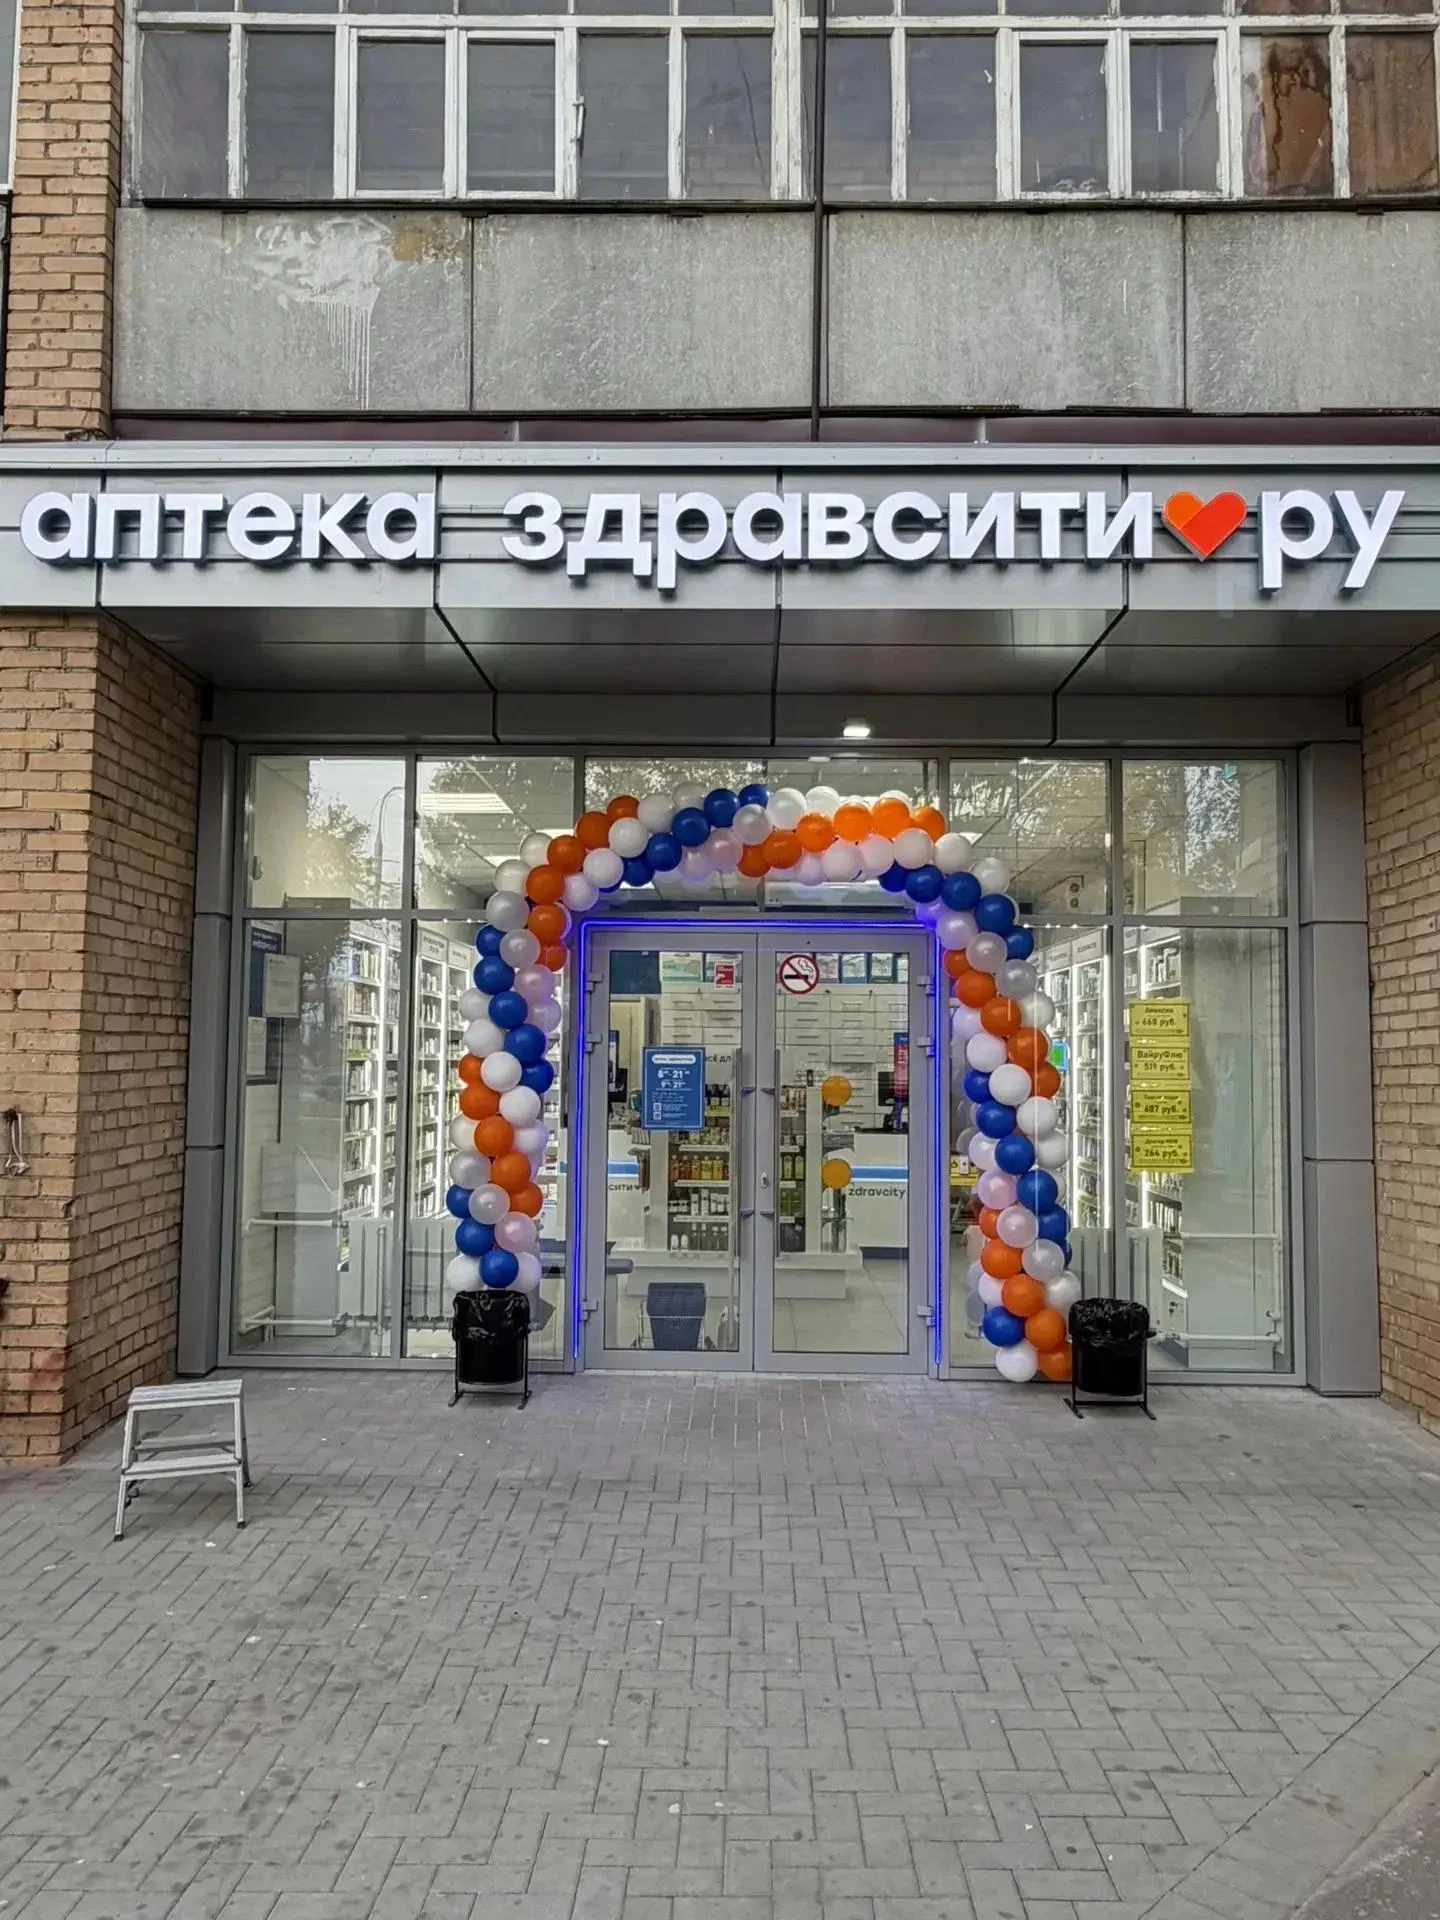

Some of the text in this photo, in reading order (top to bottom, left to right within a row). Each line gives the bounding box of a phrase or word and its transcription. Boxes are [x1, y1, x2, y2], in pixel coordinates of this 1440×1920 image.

[20, 491, 437, 561] аптека
[501, 490, 1154, 590] здравсити
[848, 1186, 906, 1200] zdravcity
